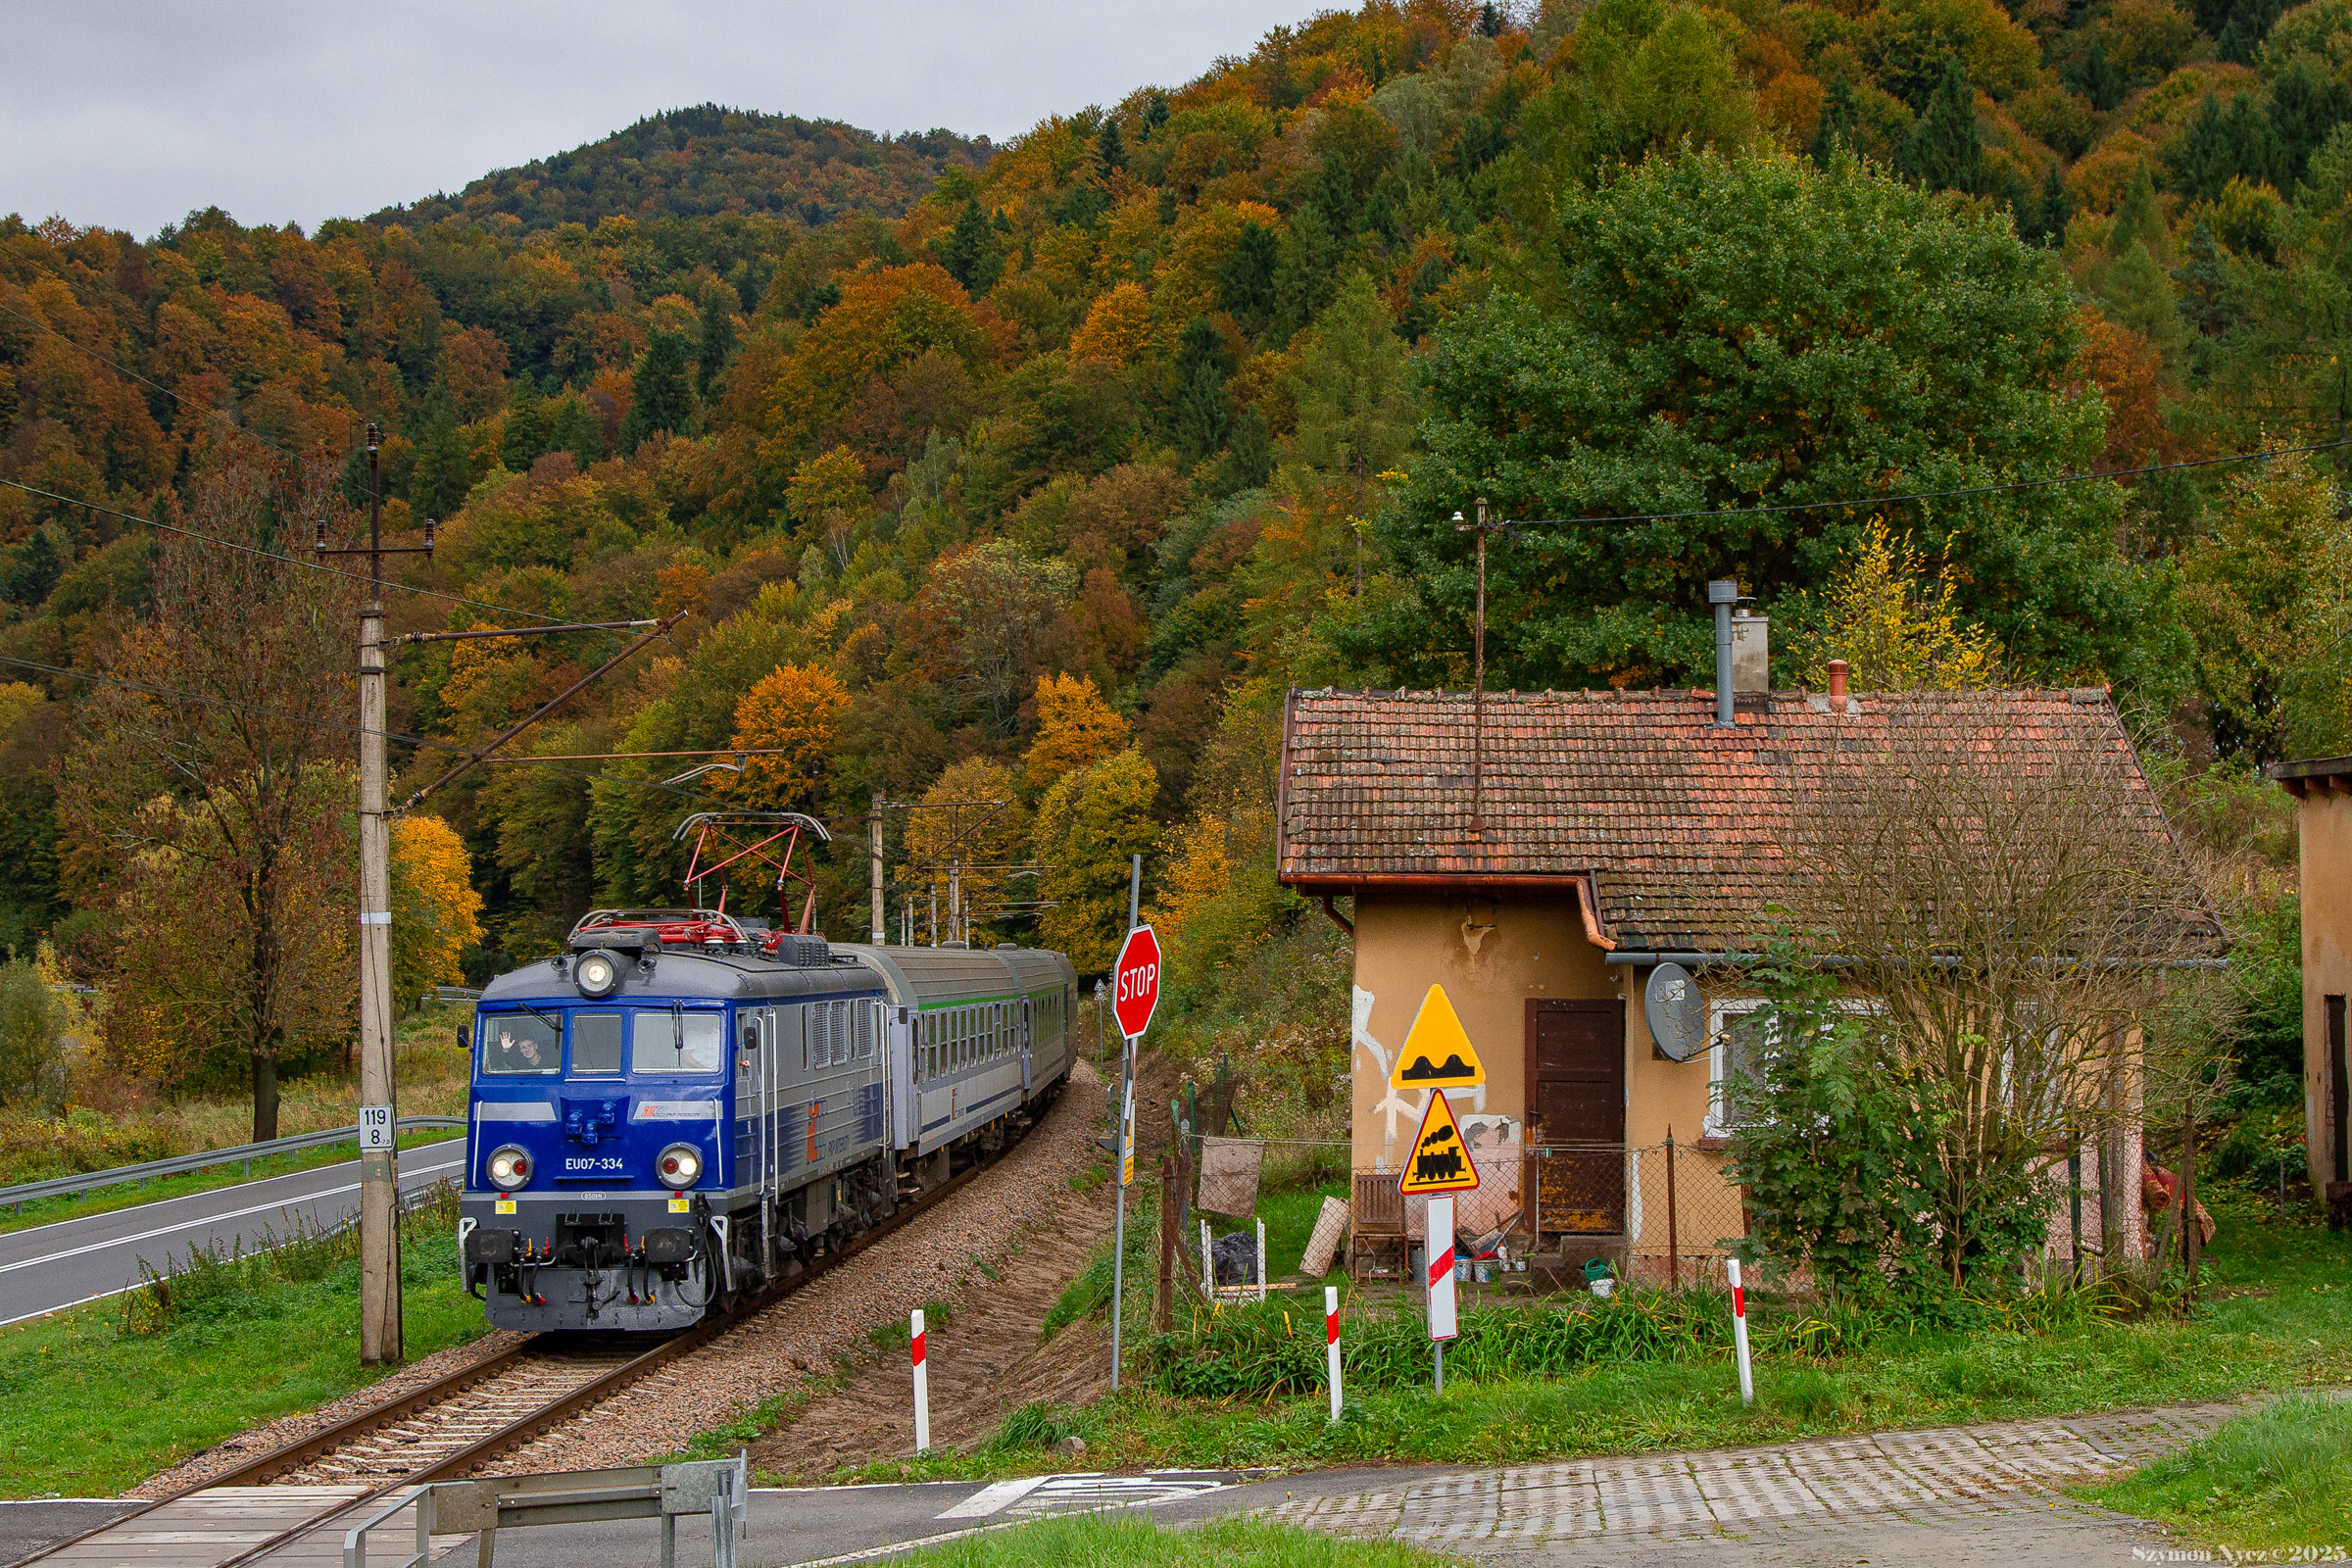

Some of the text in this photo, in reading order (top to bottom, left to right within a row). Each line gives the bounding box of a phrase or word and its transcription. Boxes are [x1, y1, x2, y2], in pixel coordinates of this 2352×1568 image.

[1119, 962, 1156, 1003] STOP
[365, 1109, 386, 1125] 119
[370, 1129, 380, 1145] 8
[565, 1157, 623, 1170] EU07-334
